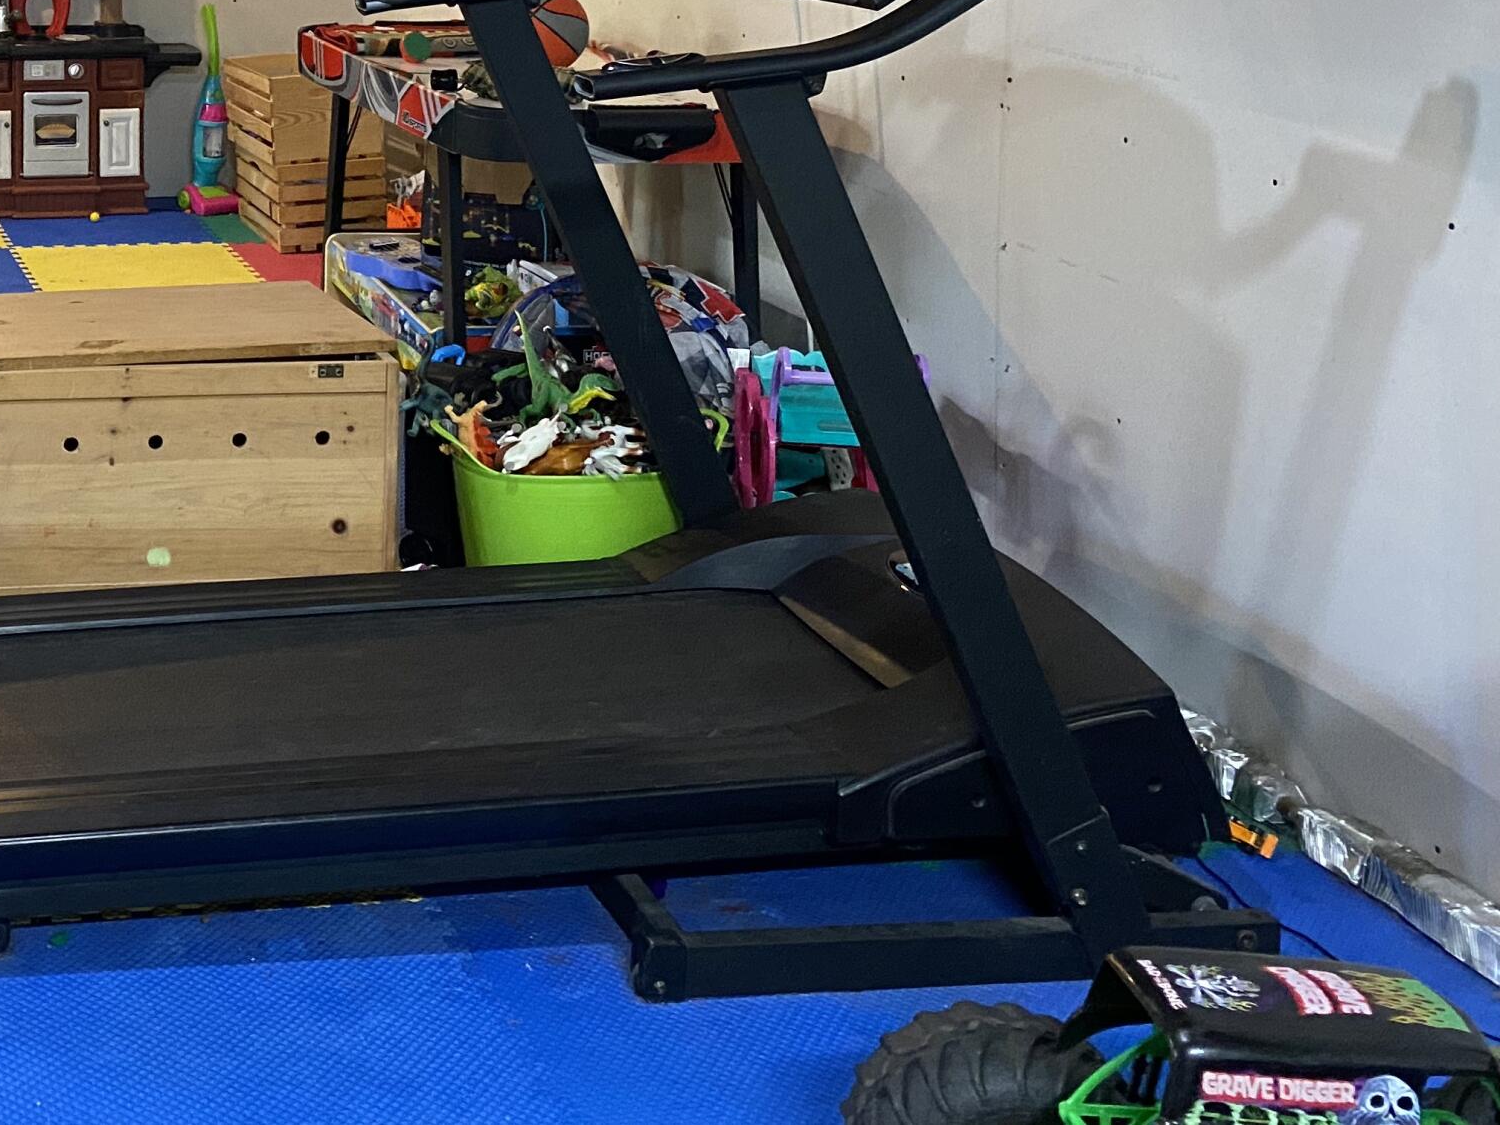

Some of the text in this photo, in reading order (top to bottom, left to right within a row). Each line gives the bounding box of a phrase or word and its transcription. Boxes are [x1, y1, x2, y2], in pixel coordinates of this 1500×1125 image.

[1158, 980, 1188, 1010] BONE
[1201, 1071, 1356, 1104] GRAVE DIGGER
